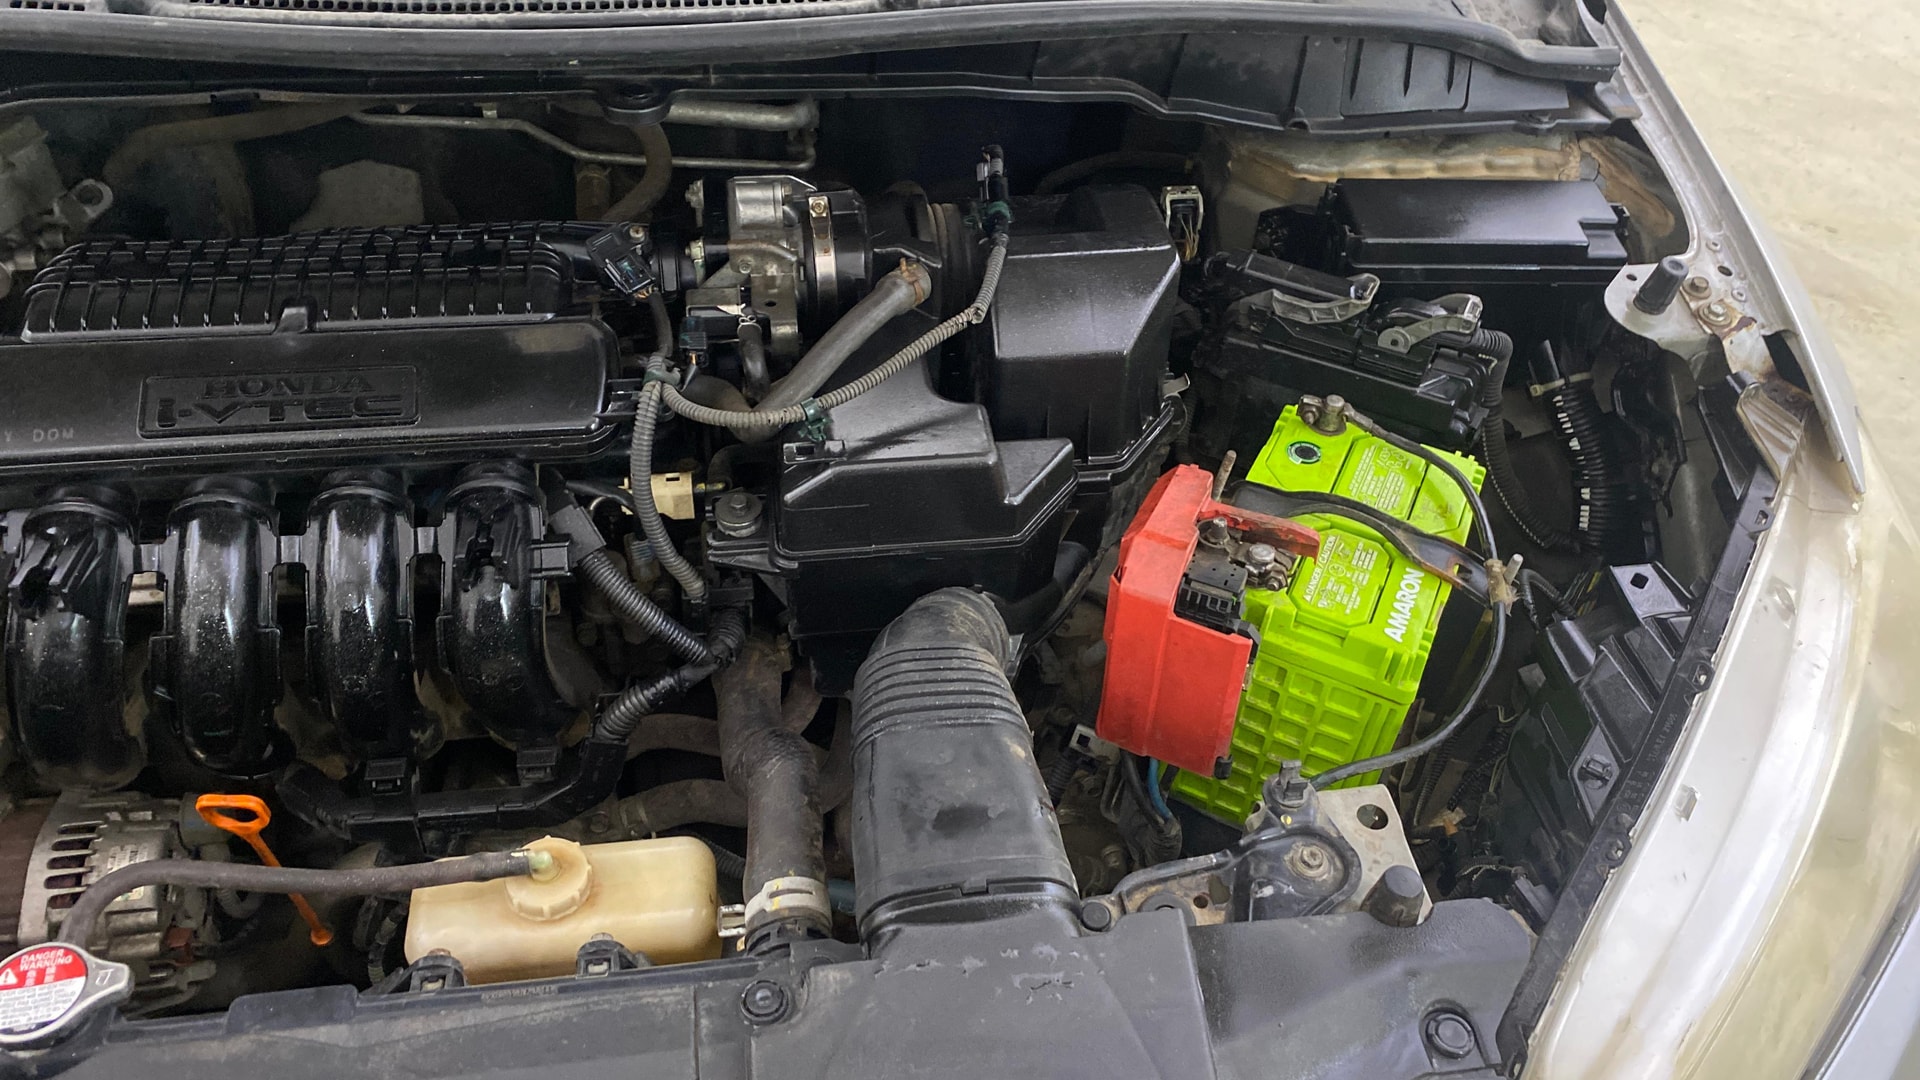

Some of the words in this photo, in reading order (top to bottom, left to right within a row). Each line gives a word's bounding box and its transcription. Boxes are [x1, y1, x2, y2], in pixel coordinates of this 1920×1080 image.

[204, 375, 375, 399] HONDA
[32, 426, 74, 443] DOM
[1305, 567, 1321, 594] DANGER
[1318, 535, 1336, 564] CAUTION
[1384, 567, 1425, 643] AMARON
[21, 948, 65, 963] DANGER
